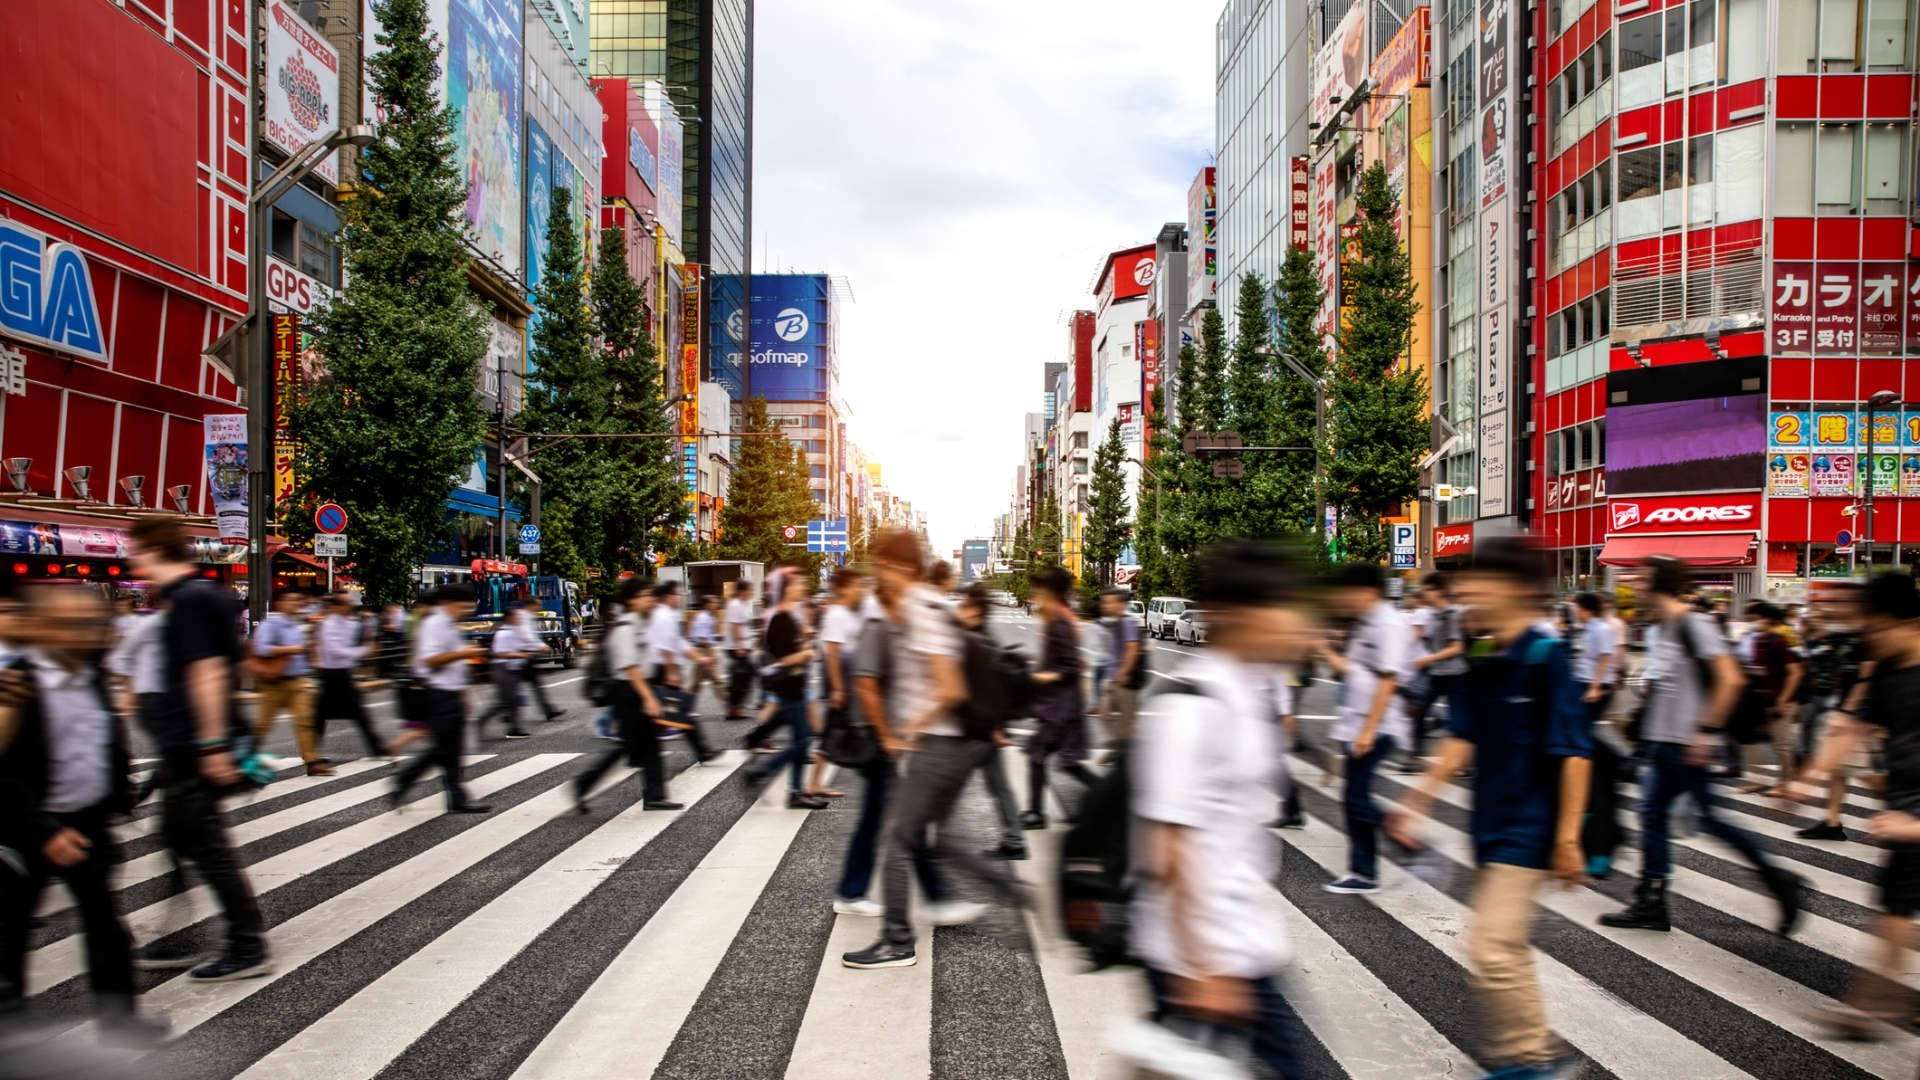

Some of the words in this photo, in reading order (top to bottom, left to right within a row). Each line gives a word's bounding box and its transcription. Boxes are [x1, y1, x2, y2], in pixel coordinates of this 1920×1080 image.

[269, 120, 287, 144] BIG
[1490, 222, 1499, 303] Anime
[267, 263, 310, 311] GPS
[1774, 313, 1811, 321] Karaoke
[1832, 315, 1854, 324] Party
[1777, 329, 1808, 346] 3F
[1817, 329, 1854, 348] 受付
[1490, 311, 1499, 387] Plaza
[1562, 473, 1605, 504] ゲーム
[1644, 504, 1752, 524] ADORES
[522, 530, 537, 538] 437
[1398, 528, 1411, 544] P
[1394, 555, 1406, 564] IN
